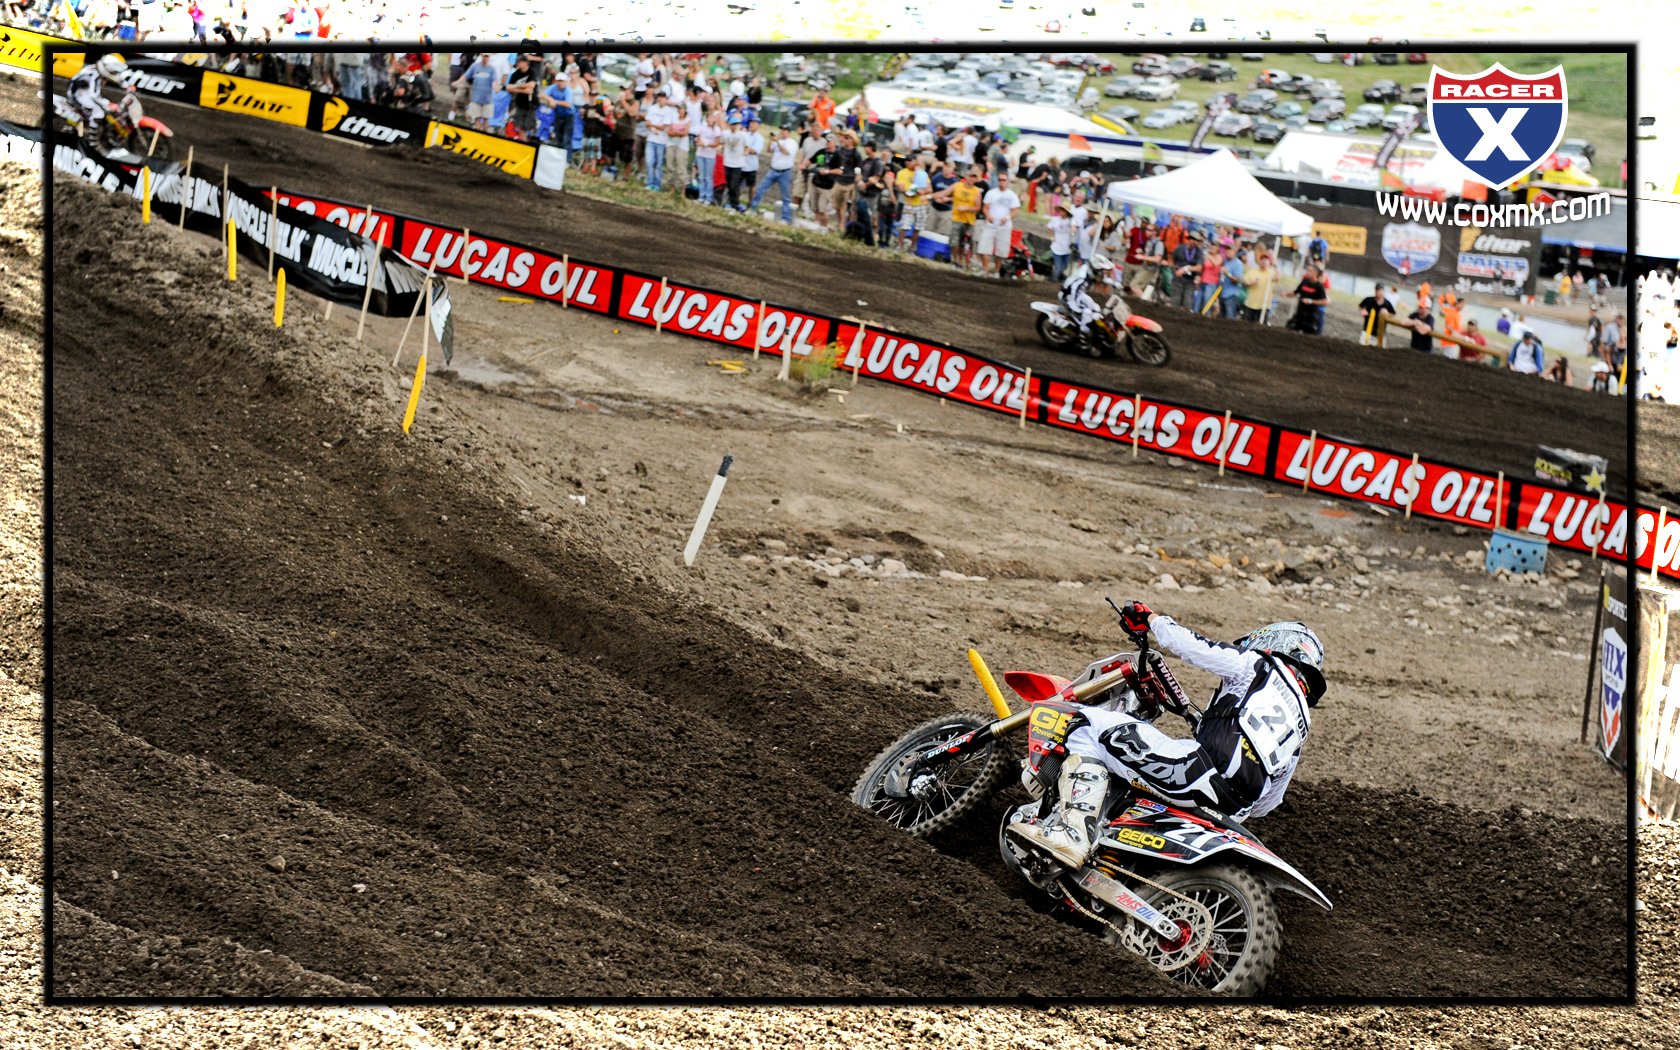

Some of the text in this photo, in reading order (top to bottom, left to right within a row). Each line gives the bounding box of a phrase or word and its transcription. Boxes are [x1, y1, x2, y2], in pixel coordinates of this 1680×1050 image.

[339, 115, 411, 143] thor
[410, 227, 536, 288] LUCAS
[540, 260, 599, 306] OIL
[628, 281, 816, 356] LUCAS OIL
[843, 331, 1027, 411] LUCAS OIL
[1058, 388, 1255, 467] LUCAS OIL
[1285, 438, 1427, 506] LUCAS
[1431, 470, 1495, 523] OIL
[1157, 660, 1191, 706] RENTHAL
[1030, 706, 1073, 736] GE
[1032, 725, 1064, 744] Powersp
[926, 734, 971, 759] DUNLOP
[1118, 827, 1166, 850] GEICO
[1162, 823, 1223, 849] 21
[1115, 891, 1156, 921] AMSOIL
